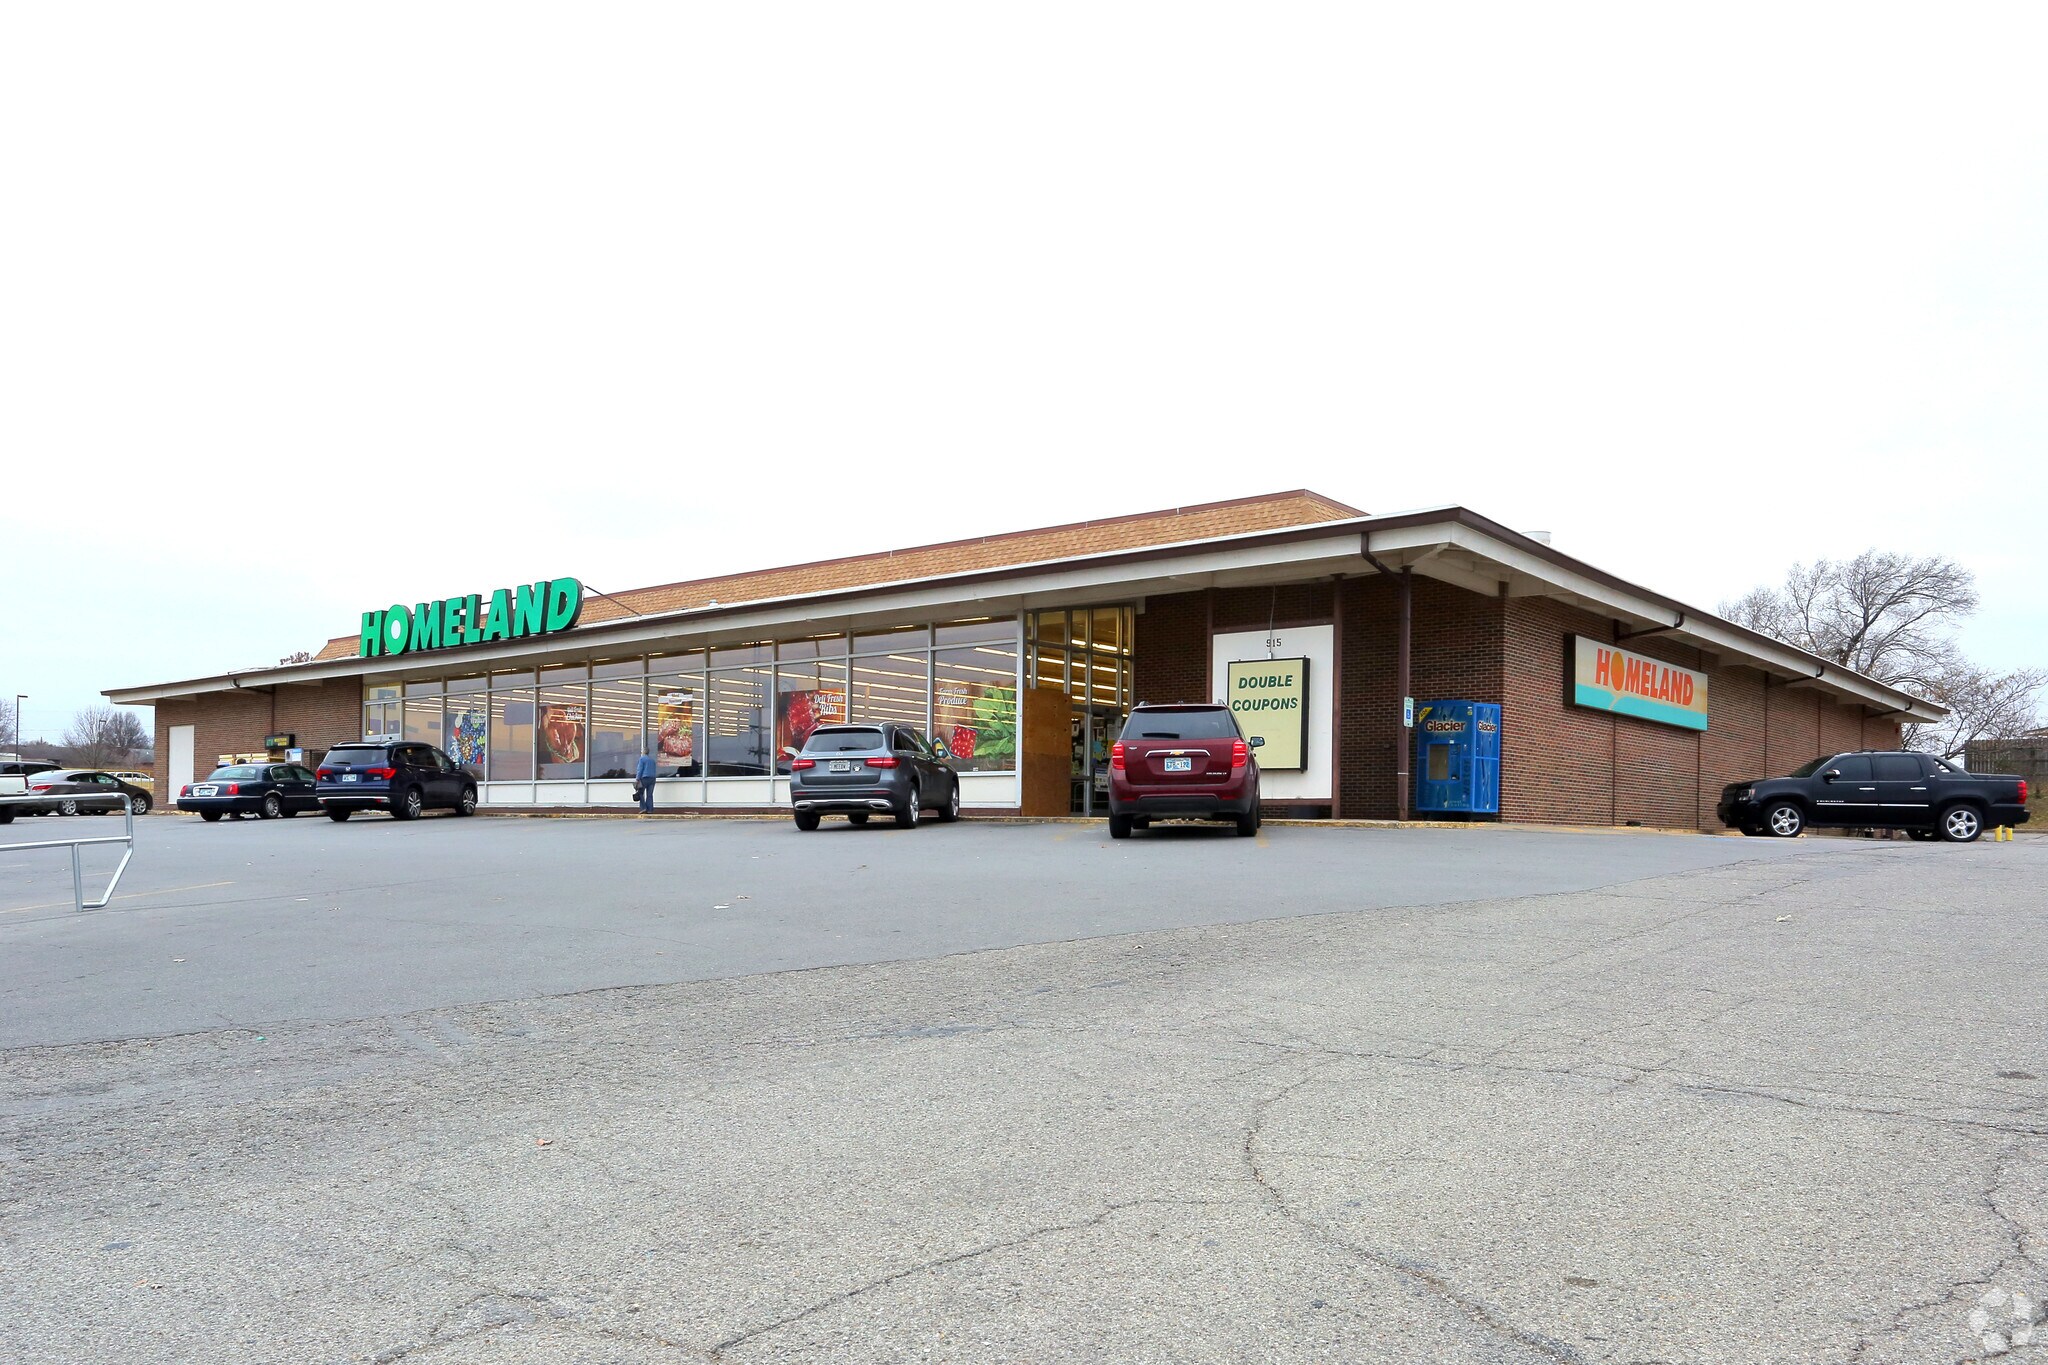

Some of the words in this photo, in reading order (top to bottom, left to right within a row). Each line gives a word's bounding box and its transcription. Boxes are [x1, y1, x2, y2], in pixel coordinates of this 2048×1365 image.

[359, 577, 584, 657] HOMELAND
[1266, 638, 1282, 648] 915
[1238, 675, 1293, 689] DOUBLE
[1595, 647, 1694, 706] HOMELAND
[814, 694, 826, 704] Deli
[827, 693, 843, 703] Fresh
[938, 695, 968, 705] Produce
[1232, 697, 1298, 712] COUPONS
[820, 703, 837, 715] Ribs
[1425, 720, 1466, 732] Glacier
[1477, 720, 1497, 732] Glacier
